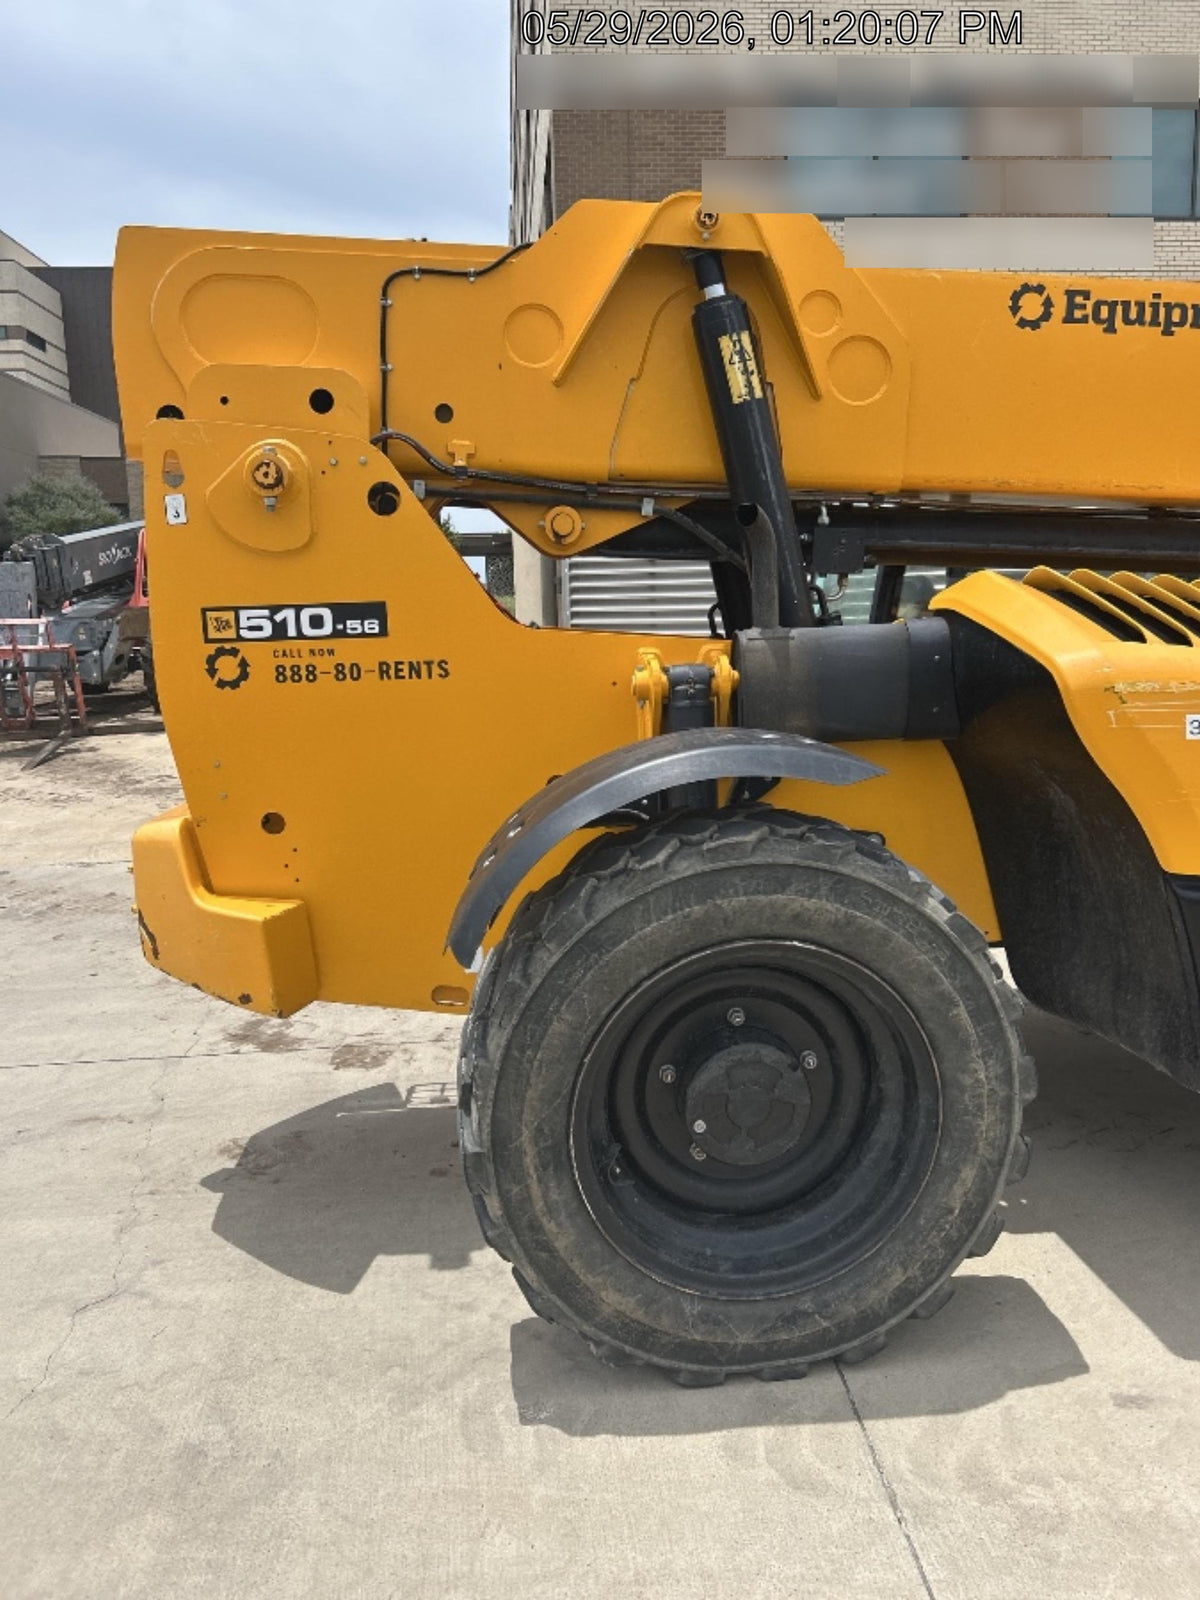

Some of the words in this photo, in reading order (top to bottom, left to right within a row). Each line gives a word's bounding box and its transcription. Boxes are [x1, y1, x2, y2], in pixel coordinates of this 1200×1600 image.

[272, 649, 303, 659] CALL
[309, 648, 336, 657] NOW
[274, 659, 450, 683] 888-80-RENTS
